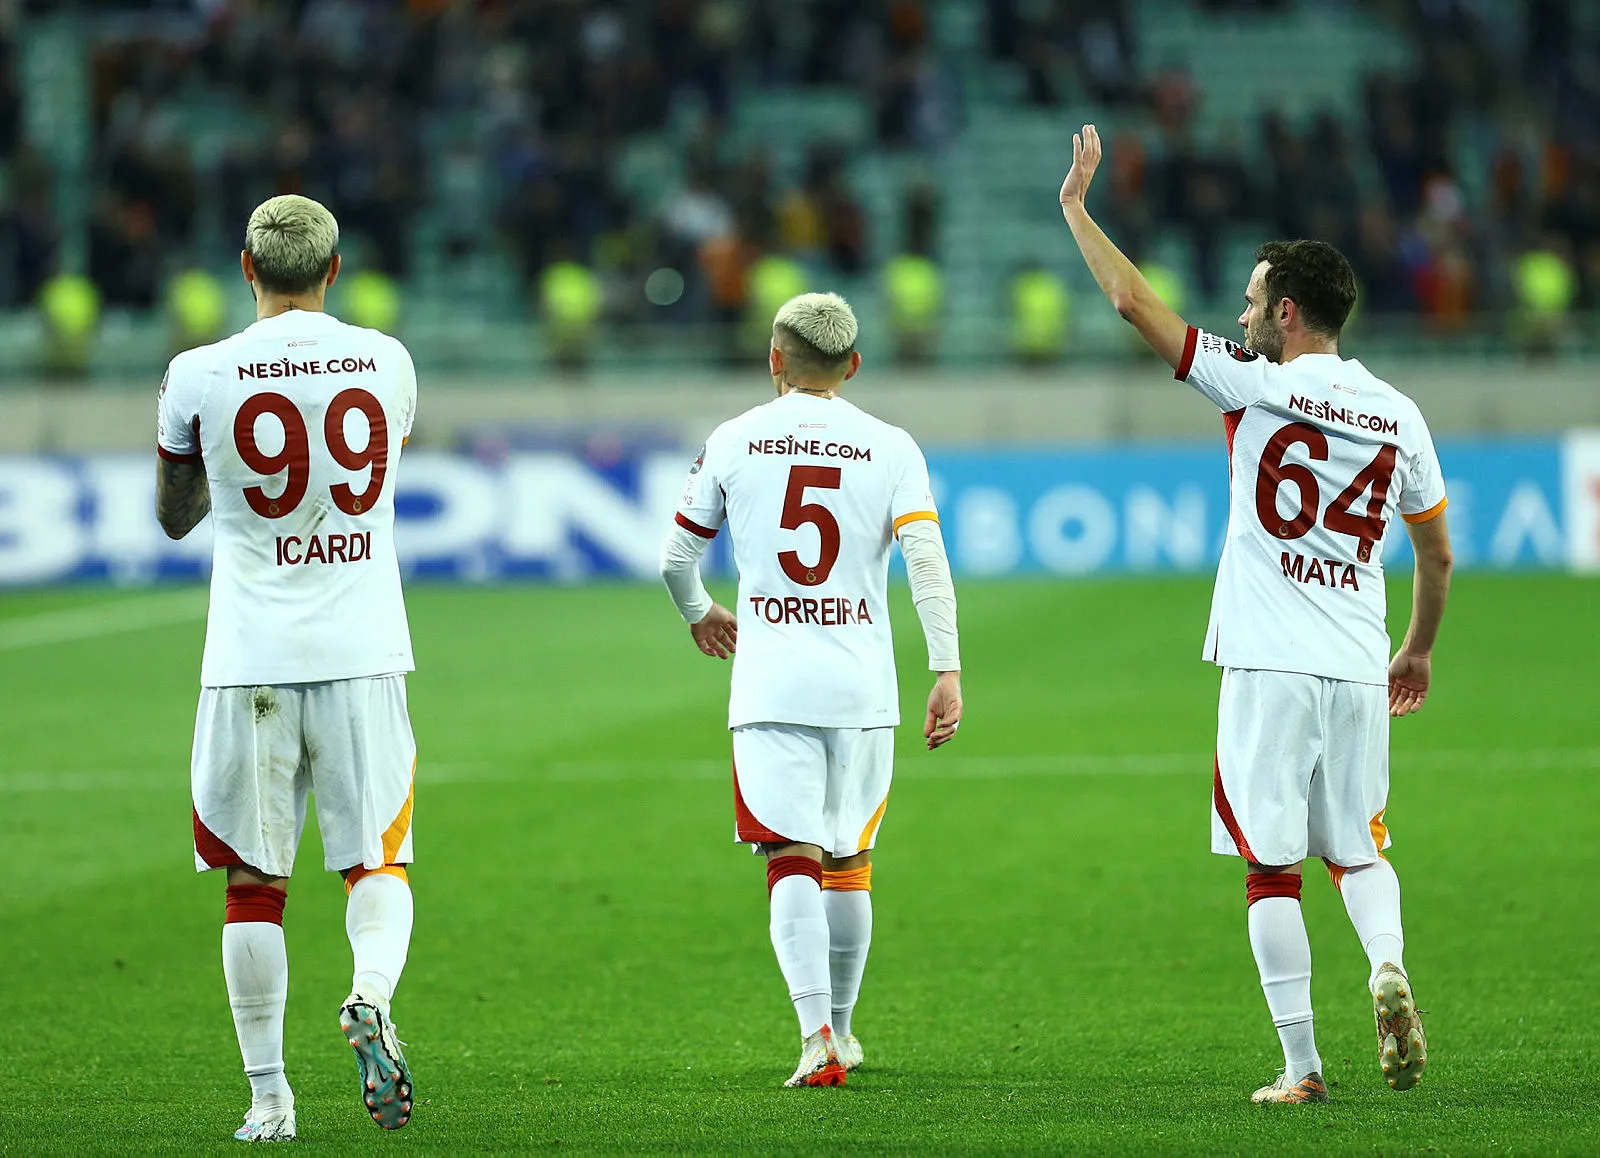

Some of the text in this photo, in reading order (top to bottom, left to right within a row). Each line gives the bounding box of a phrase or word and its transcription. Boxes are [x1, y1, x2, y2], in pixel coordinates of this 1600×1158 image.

[233, 387, 389, 520] 99
[1255, 421, 1398, 563] 64
[275, 531, 371, 566] ICARDI
[777, 465, 841, 587] 5
[955, 482, 1230, 574] BON
[1280, 551, 1359, 592] MATA
[750, 596, 873, 626] TORREIRA
